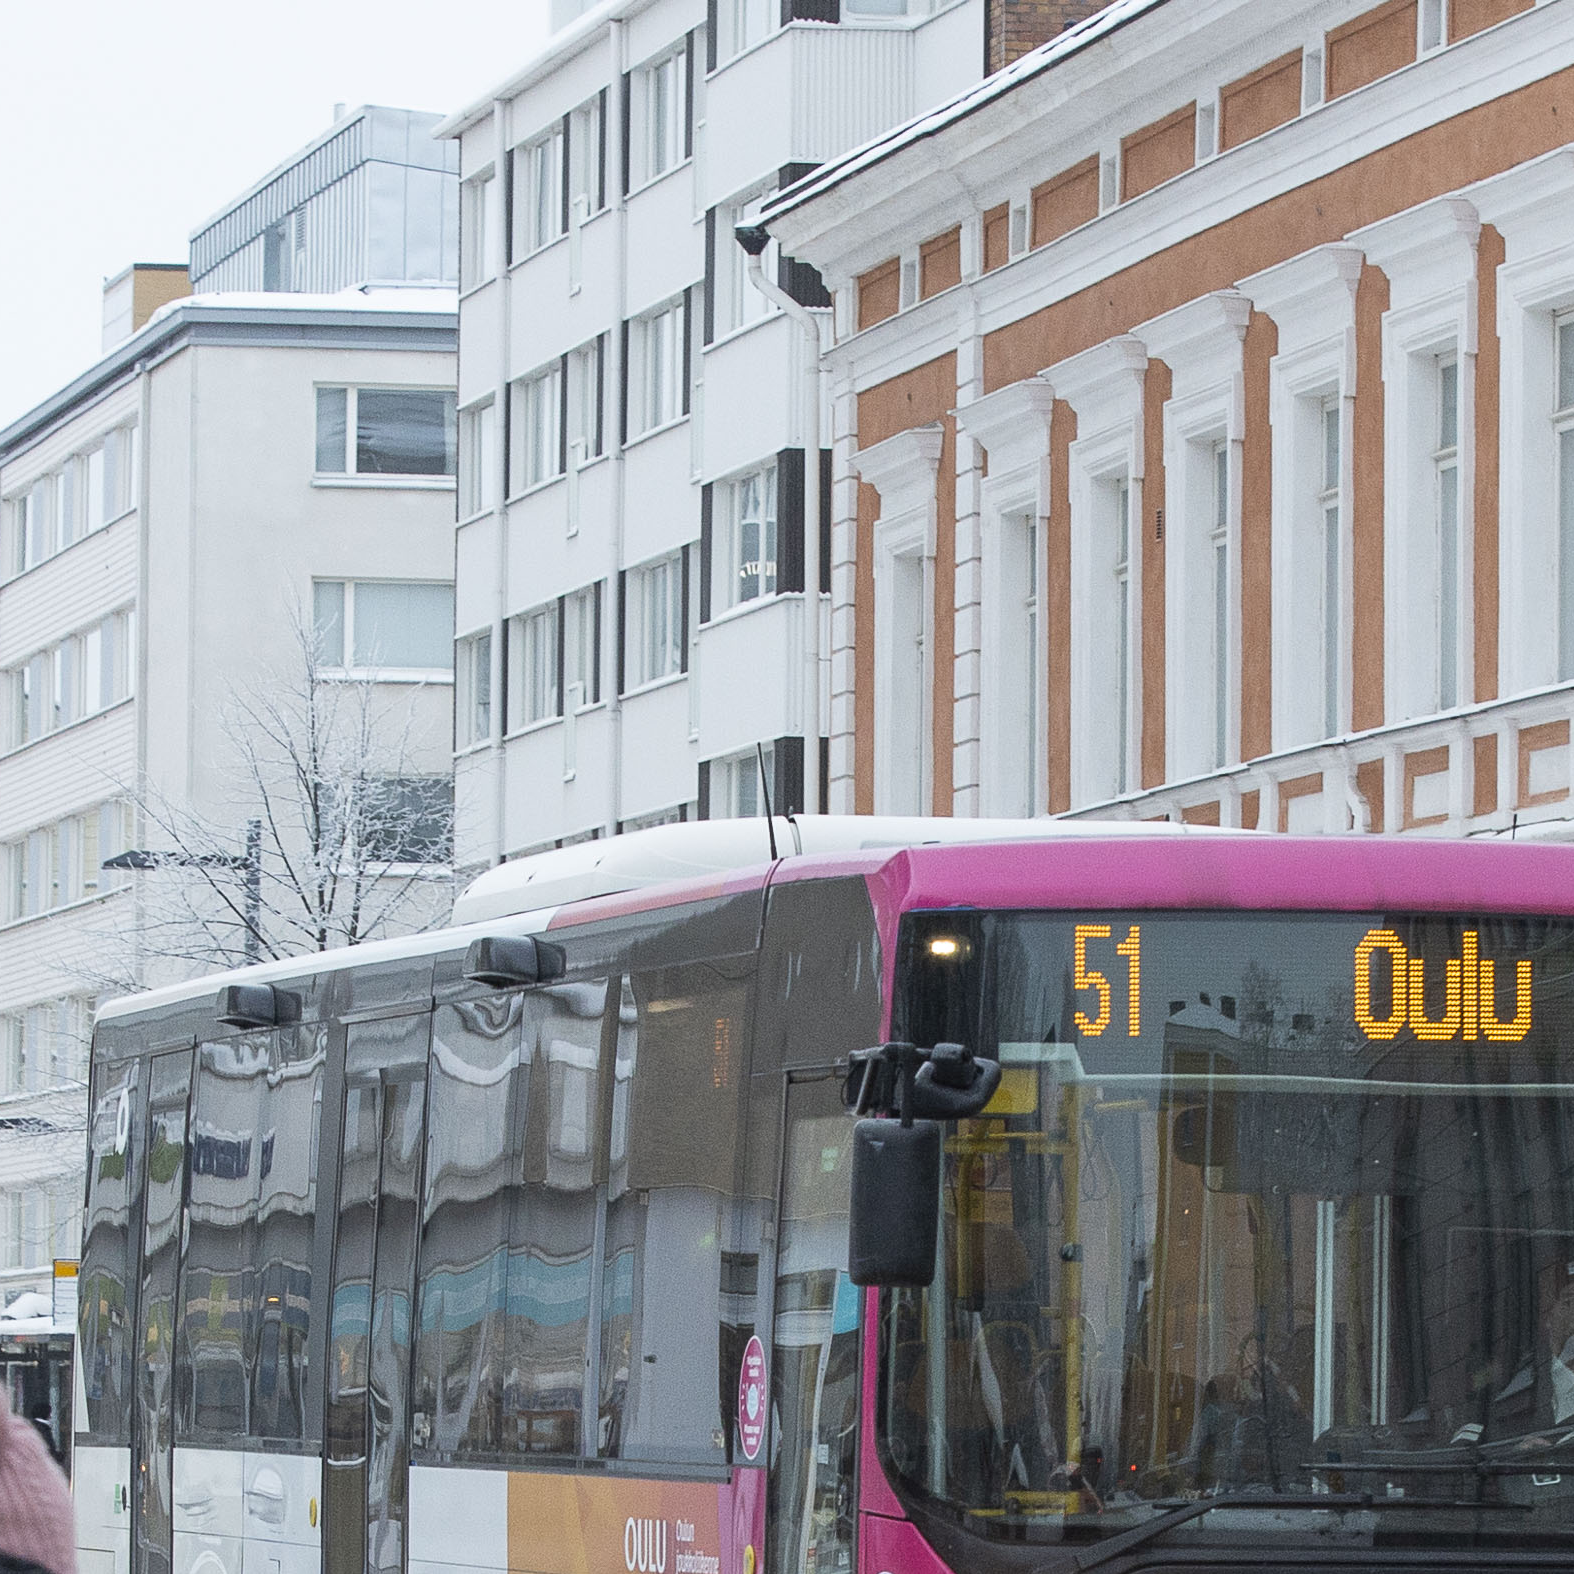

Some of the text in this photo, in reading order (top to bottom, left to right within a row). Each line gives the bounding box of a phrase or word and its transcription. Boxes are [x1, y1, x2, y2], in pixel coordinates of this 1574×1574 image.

[1074, 925, 1532, 1042] 51 Oulu
[625, 1516, 667, 1574] OULU
